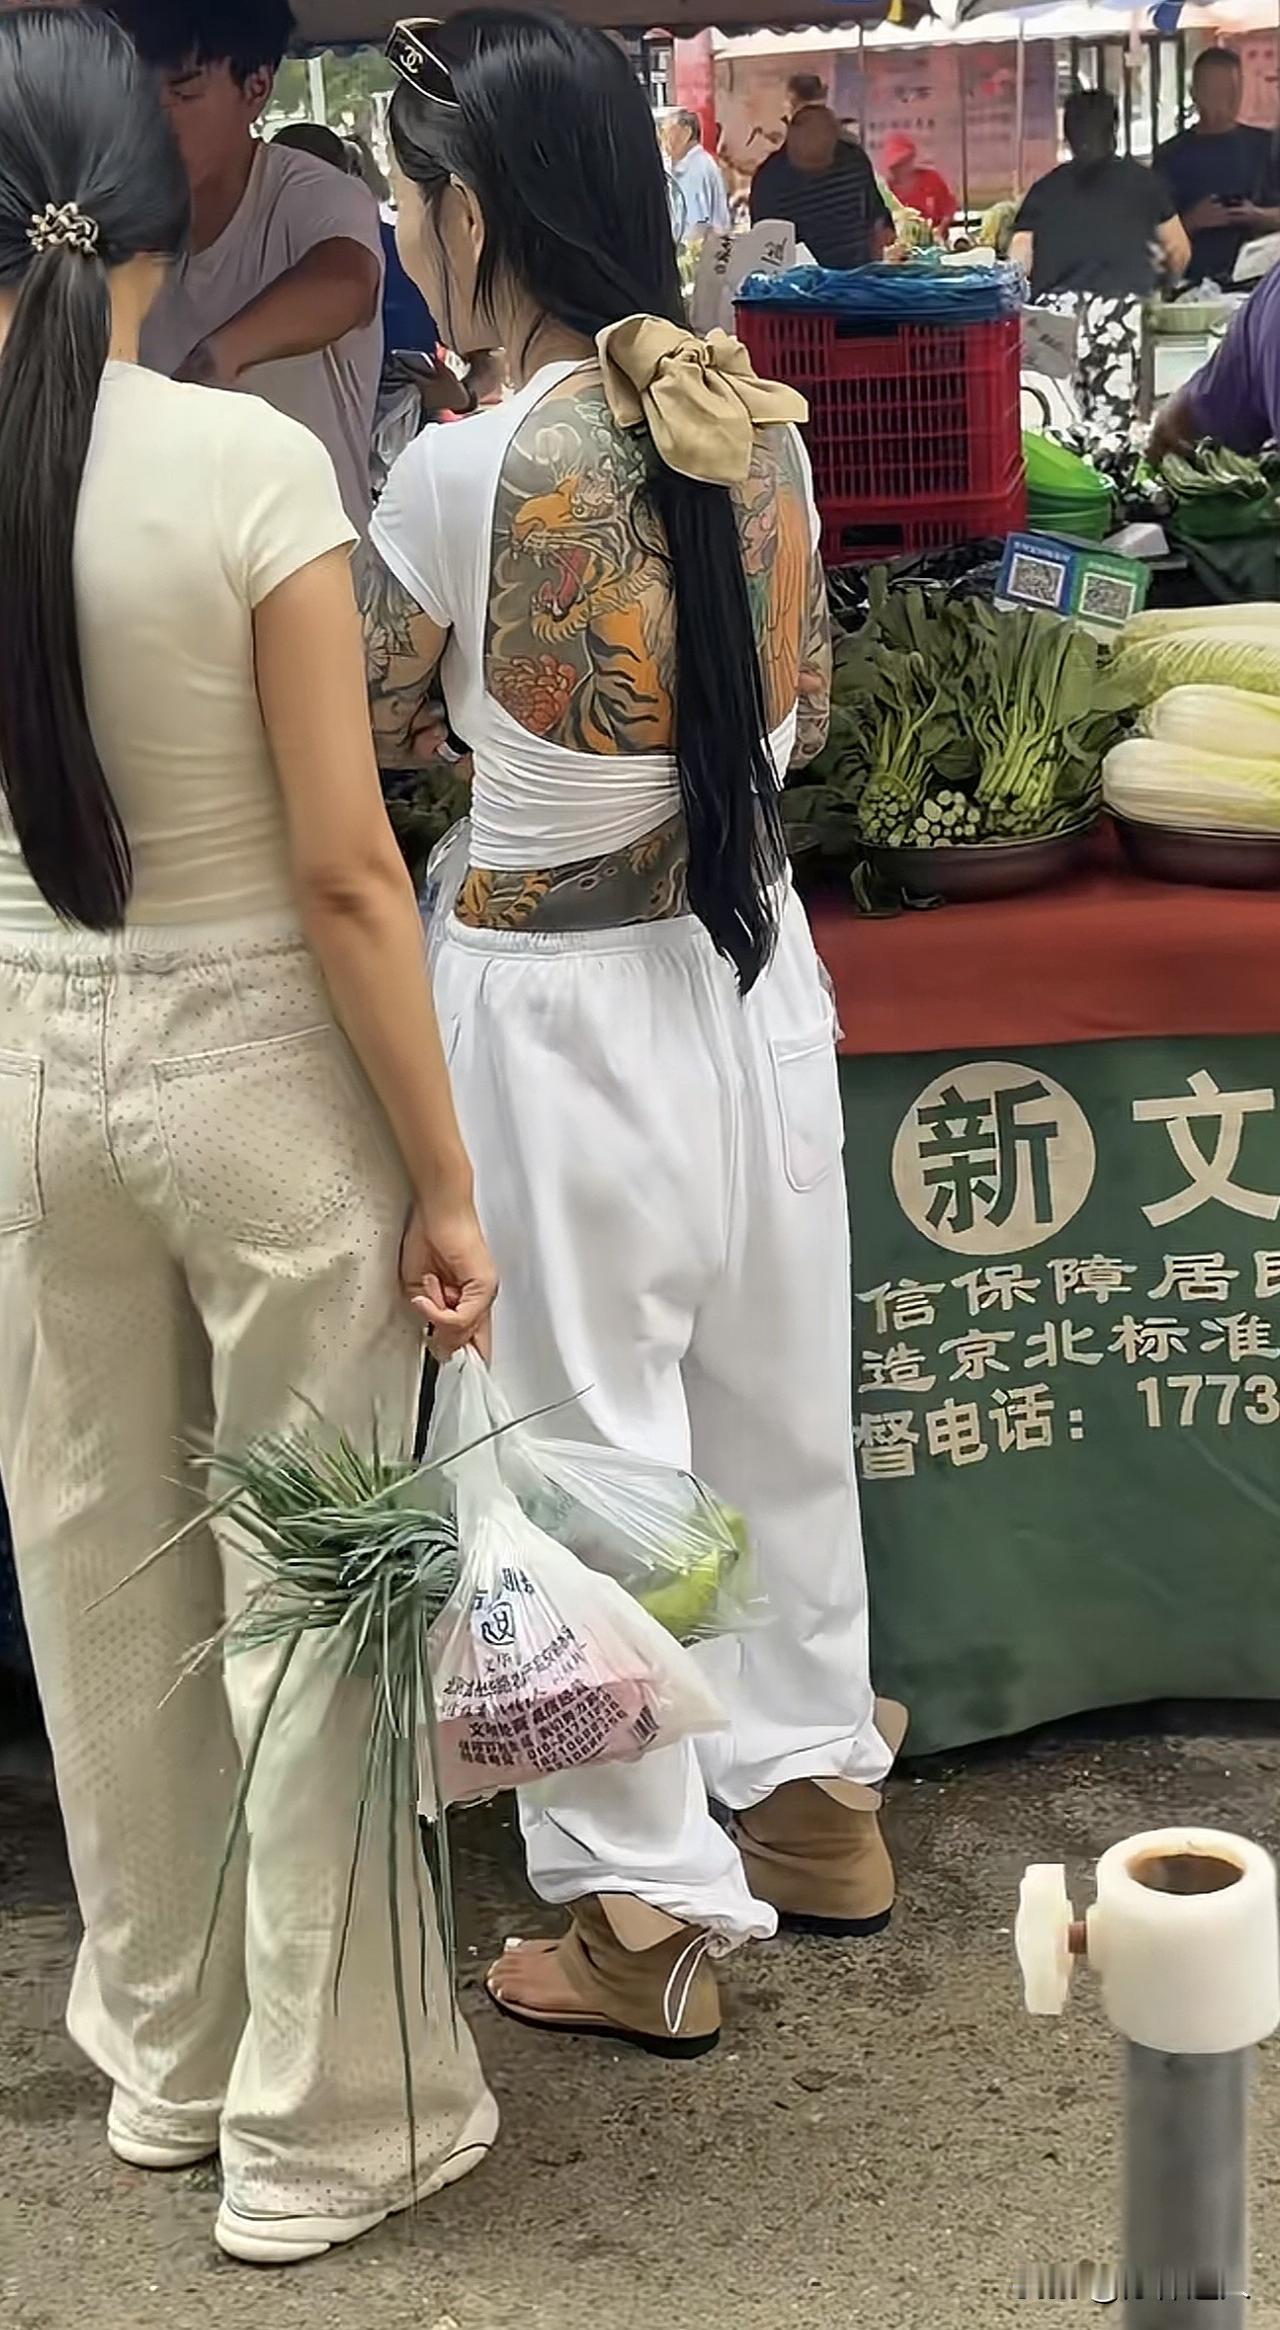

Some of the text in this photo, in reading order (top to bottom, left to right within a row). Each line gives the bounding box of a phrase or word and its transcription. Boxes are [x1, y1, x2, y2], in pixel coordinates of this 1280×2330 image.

[917, 1068, 1280, 1234] 新 文
[1136, 1374, 1280, 1428] 1773
